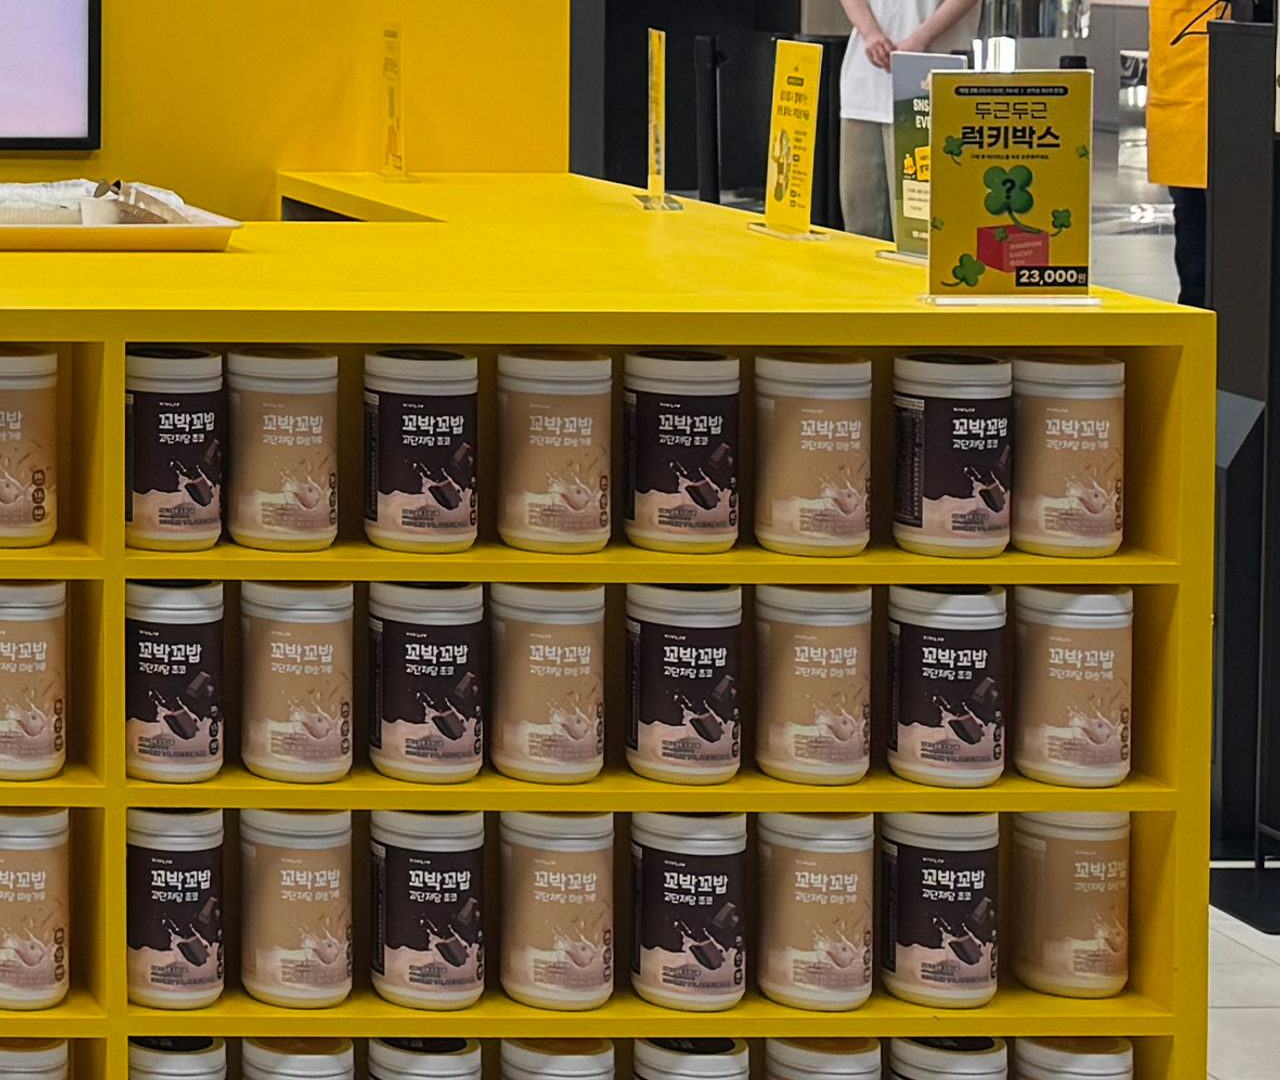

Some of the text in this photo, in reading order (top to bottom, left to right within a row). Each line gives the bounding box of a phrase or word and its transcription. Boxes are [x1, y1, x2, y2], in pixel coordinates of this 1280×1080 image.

[975, 102, 1048, 119] 두근두근
[961, 125, 1061, 149] 럭키박스
[1019, 270, 1086, 285] 23,000원
[158, 412, 216, 432] 꼬박꼬밥
[401, 414, 465, 435] 꼬박꼬밥
[658, 414, 724, 435] 꼬박꼬밥
[138, 642, 202, 664] 꼬박꼬밥
[404, 643, 469, 665] 꼬박꼬밥
[662, 645, 728, 667] 꼬박꼬밥
[921, 647, 988, 669] 꼬박꼬밥
[150, 869, 212, 890] 꼬박꼬밥
[408, 869, 471, 891] 꼬박꼬밥
[663, 872, 729, 894] 꼬박꼬밥
[921, 869, 986, 890] 꼬박꼬밥
